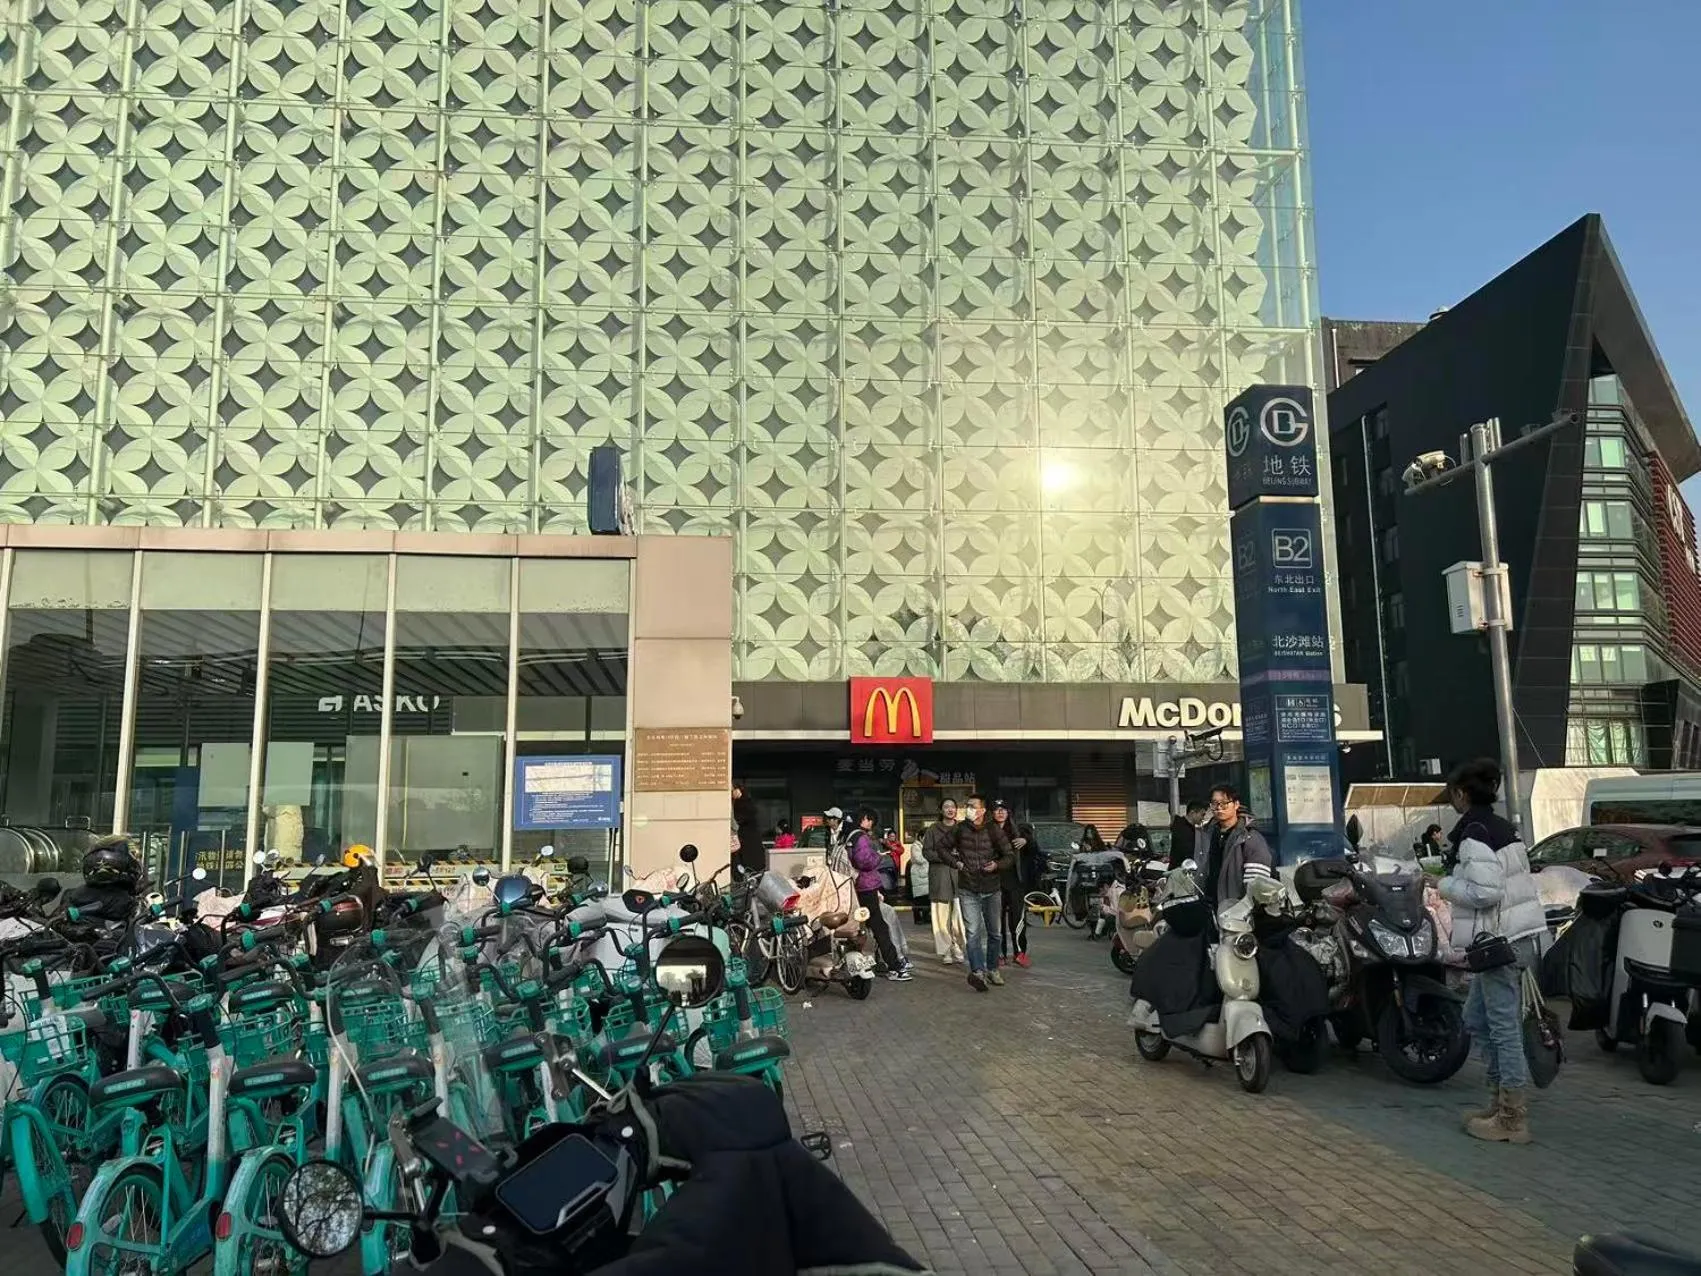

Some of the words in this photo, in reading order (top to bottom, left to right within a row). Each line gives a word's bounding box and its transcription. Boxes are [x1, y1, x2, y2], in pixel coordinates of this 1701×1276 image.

[1262, 454, 1312, 475] 地铁
[1275, 536, 1310, 561] B2
[1274, 574, 1314, 584] 东北出口
[1272, 635, 1324, 648] 北沙滩站
[939, 772, 976, 784] 甜品站
